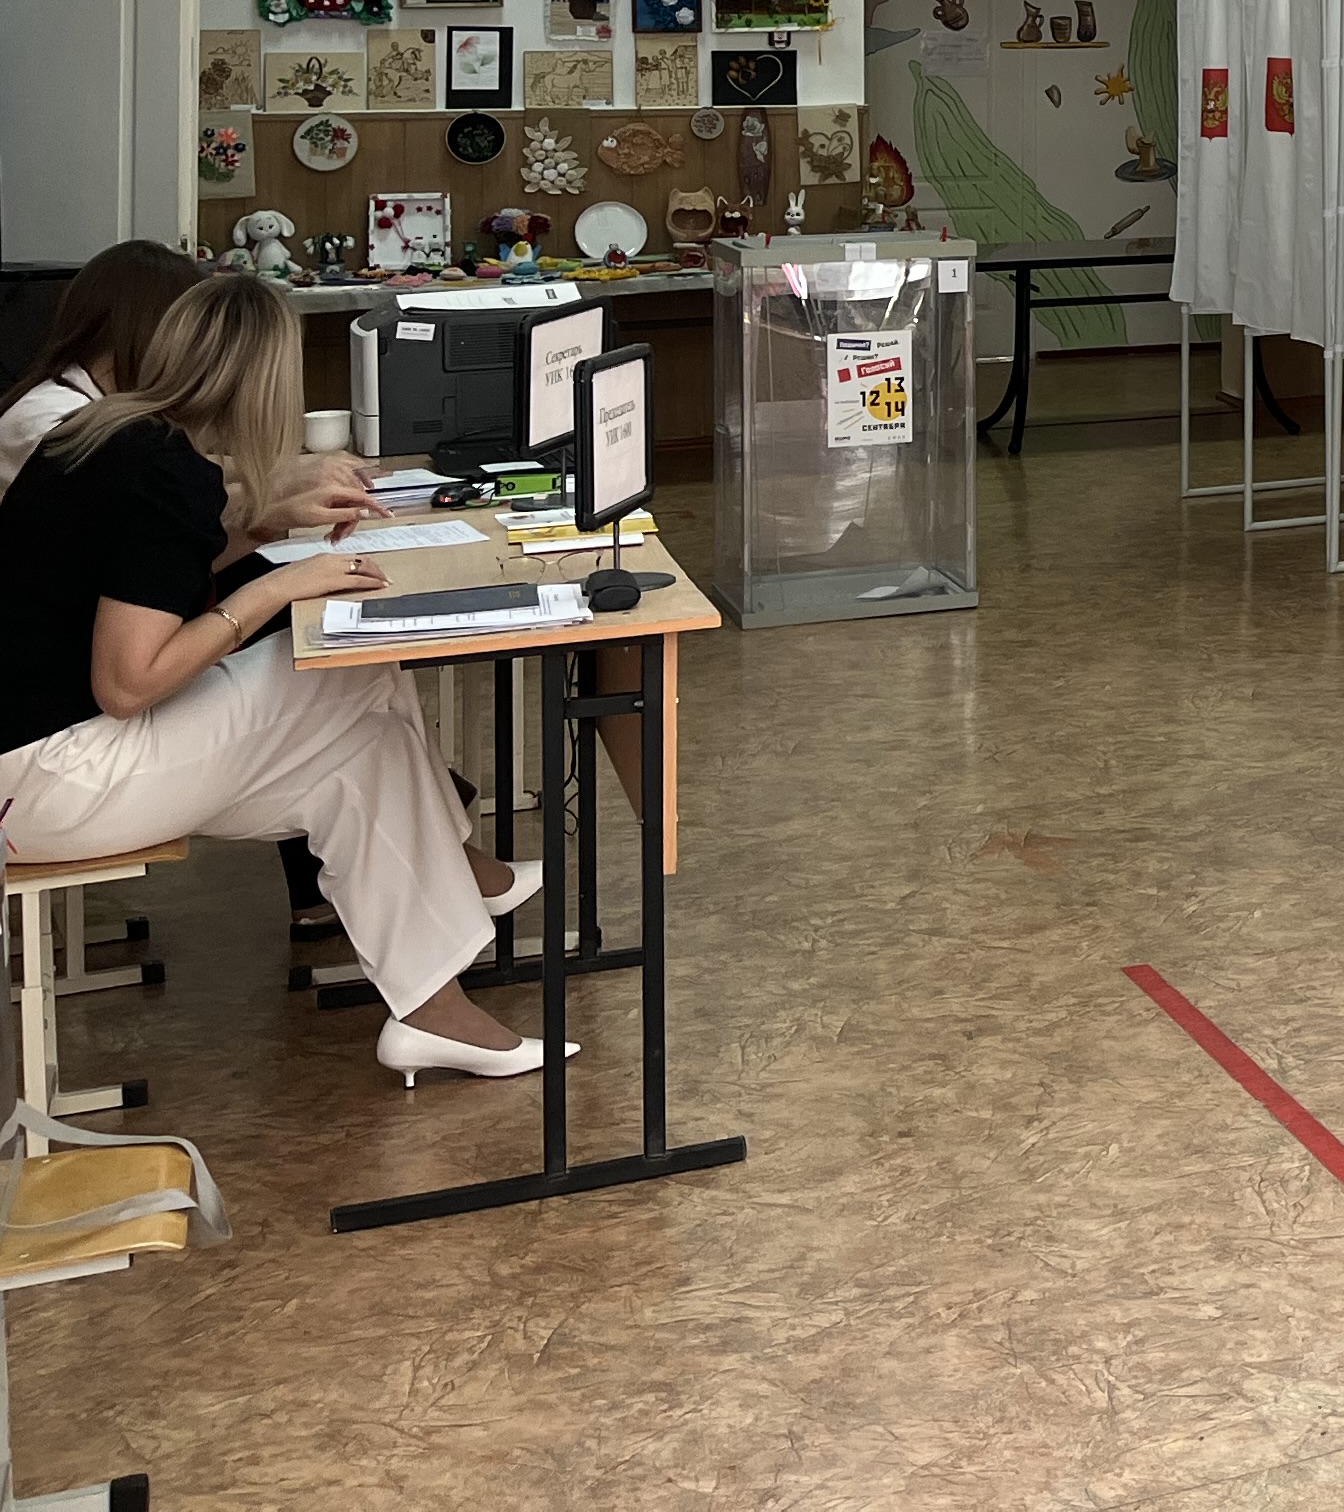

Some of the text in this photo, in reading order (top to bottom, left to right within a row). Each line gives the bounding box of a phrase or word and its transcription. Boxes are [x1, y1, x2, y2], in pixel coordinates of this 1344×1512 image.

[951, 268, 957, 278] 1
[566, 365, 574, 380] 16
[885, 377, 905, 393] 13
[860, 390, 880, 407] 12
[885, 401, 905, 418] 14
[862, 422, 906, 431] СЕНТЯБРЯ
